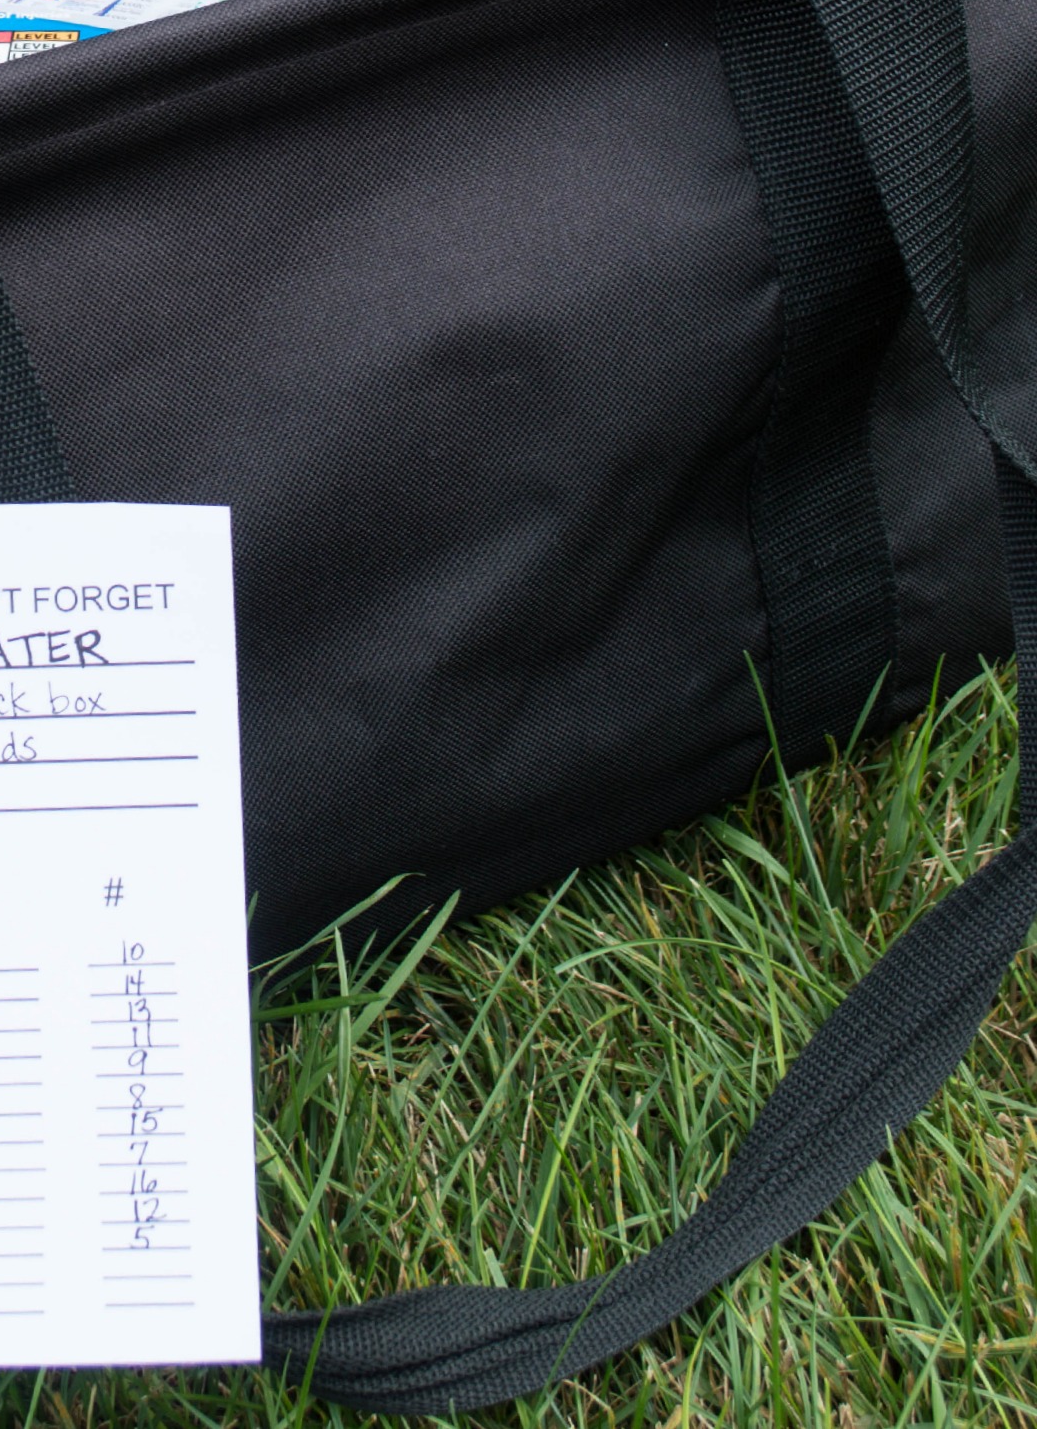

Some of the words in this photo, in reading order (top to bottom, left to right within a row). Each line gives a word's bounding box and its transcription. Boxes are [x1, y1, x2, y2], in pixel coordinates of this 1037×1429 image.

[33, 583, 176, 613] FORGET
[48, 680, 106, 716] box
[103, 876, 125, 907] #
[121, 940, 145, 966] 10
[124, 969, 145, 996] 14
[128, 997, 152, 1023] 13
[127, 1049, 148, 1076] 9
[128, 1082, 146, 1110] 8
[130, 1106, 163, 1136] 15
[129, 1140, 149, 1166] 7
[129, 1169, 158, 1196] 16
[133, 1197, 168, 1224] 12
[129, 1224, 155, 1250] 5
